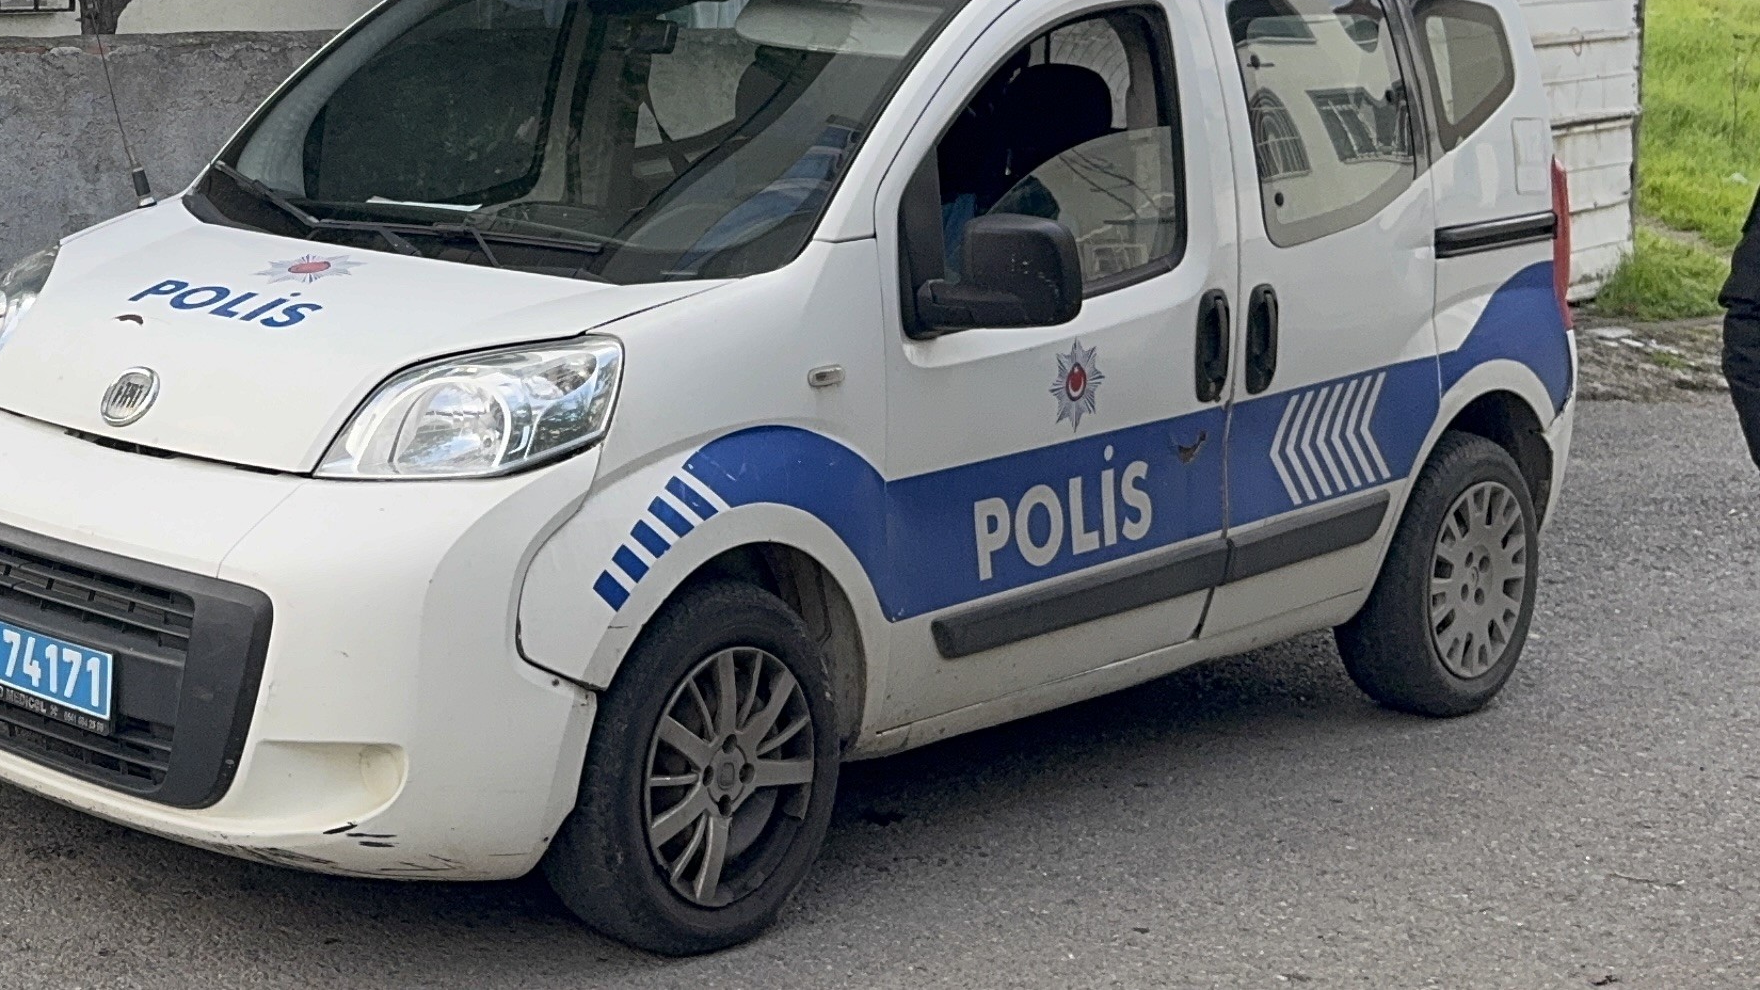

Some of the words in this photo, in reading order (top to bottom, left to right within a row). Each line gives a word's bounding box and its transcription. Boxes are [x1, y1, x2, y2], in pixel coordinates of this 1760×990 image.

[128, 279, 323, 327] POLİS
[973, 444, 1152, 581] POLİS
[2, 628, 100, 707] 74171
